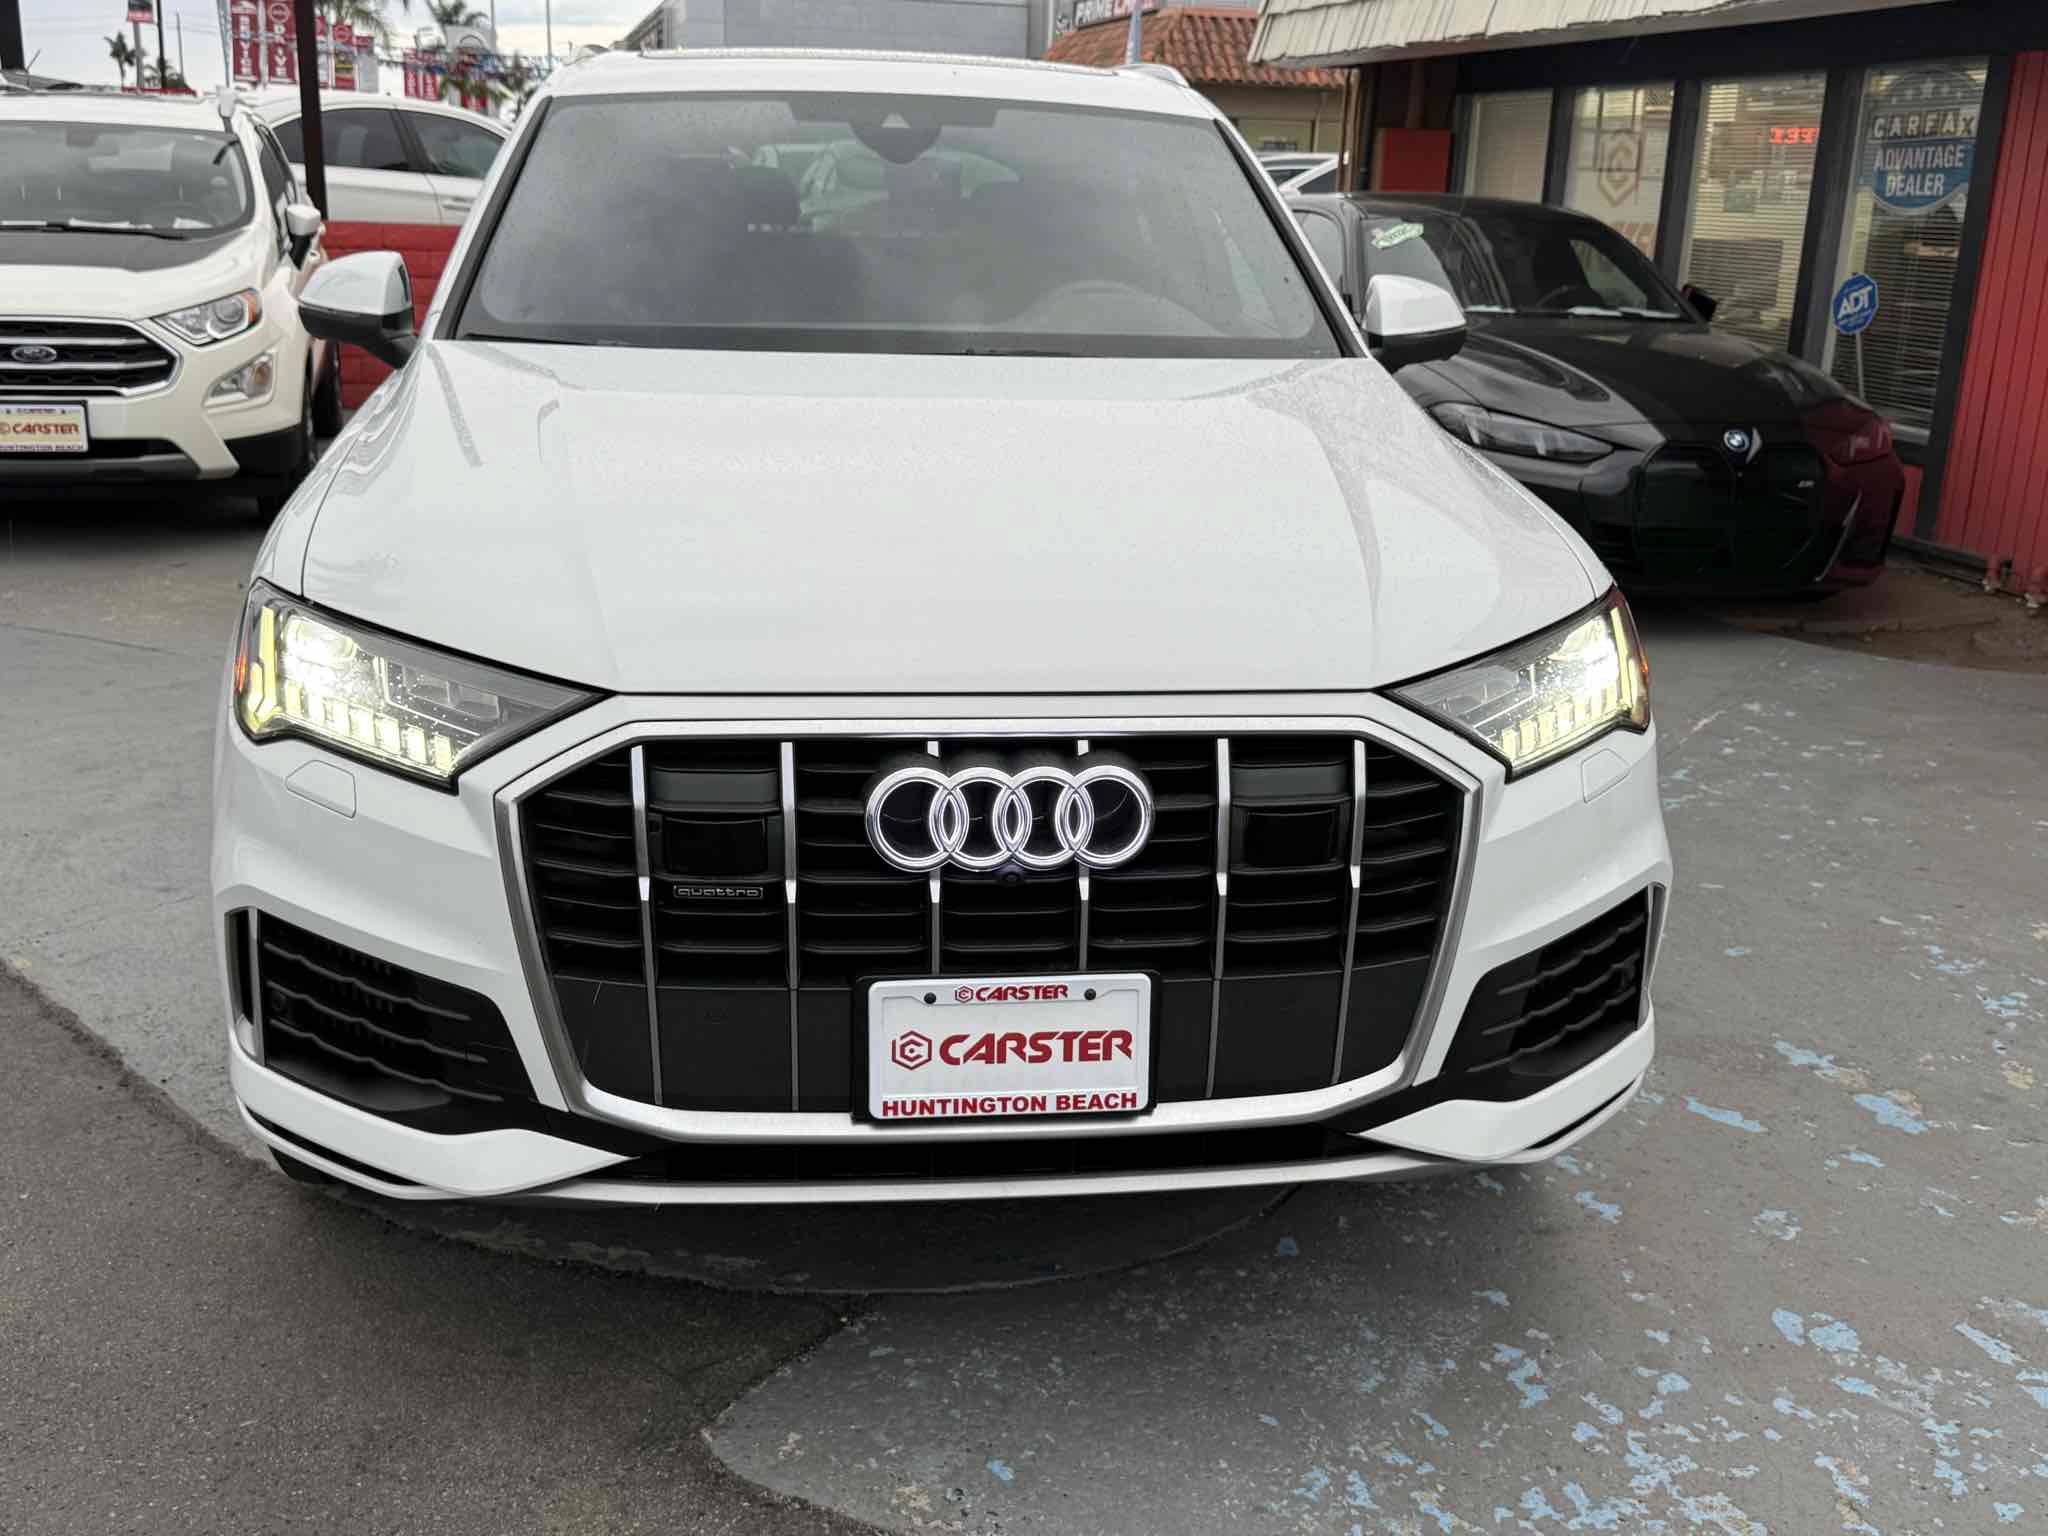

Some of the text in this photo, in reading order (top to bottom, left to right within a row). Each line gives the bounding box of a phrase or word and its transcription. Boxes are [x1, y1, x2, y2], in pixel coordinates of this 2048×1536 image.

[1873, 112, 1975, 138] CARFAX
[1872, 144, 1965, 171] ADVANTAGE
[1885, 173, 1945, 197] DEALER
[1837, 285, 1873, 320] ADT
[12, 423, 80, 434] CARSTER
[678, 888, 760, 897] quattro
[975, 984, 1068, 1001] CARSTER
[938, 1029, 1134, 1066] CARSTER
[882, 1092, 1137, 1117] HUNTINGTON BEACH
